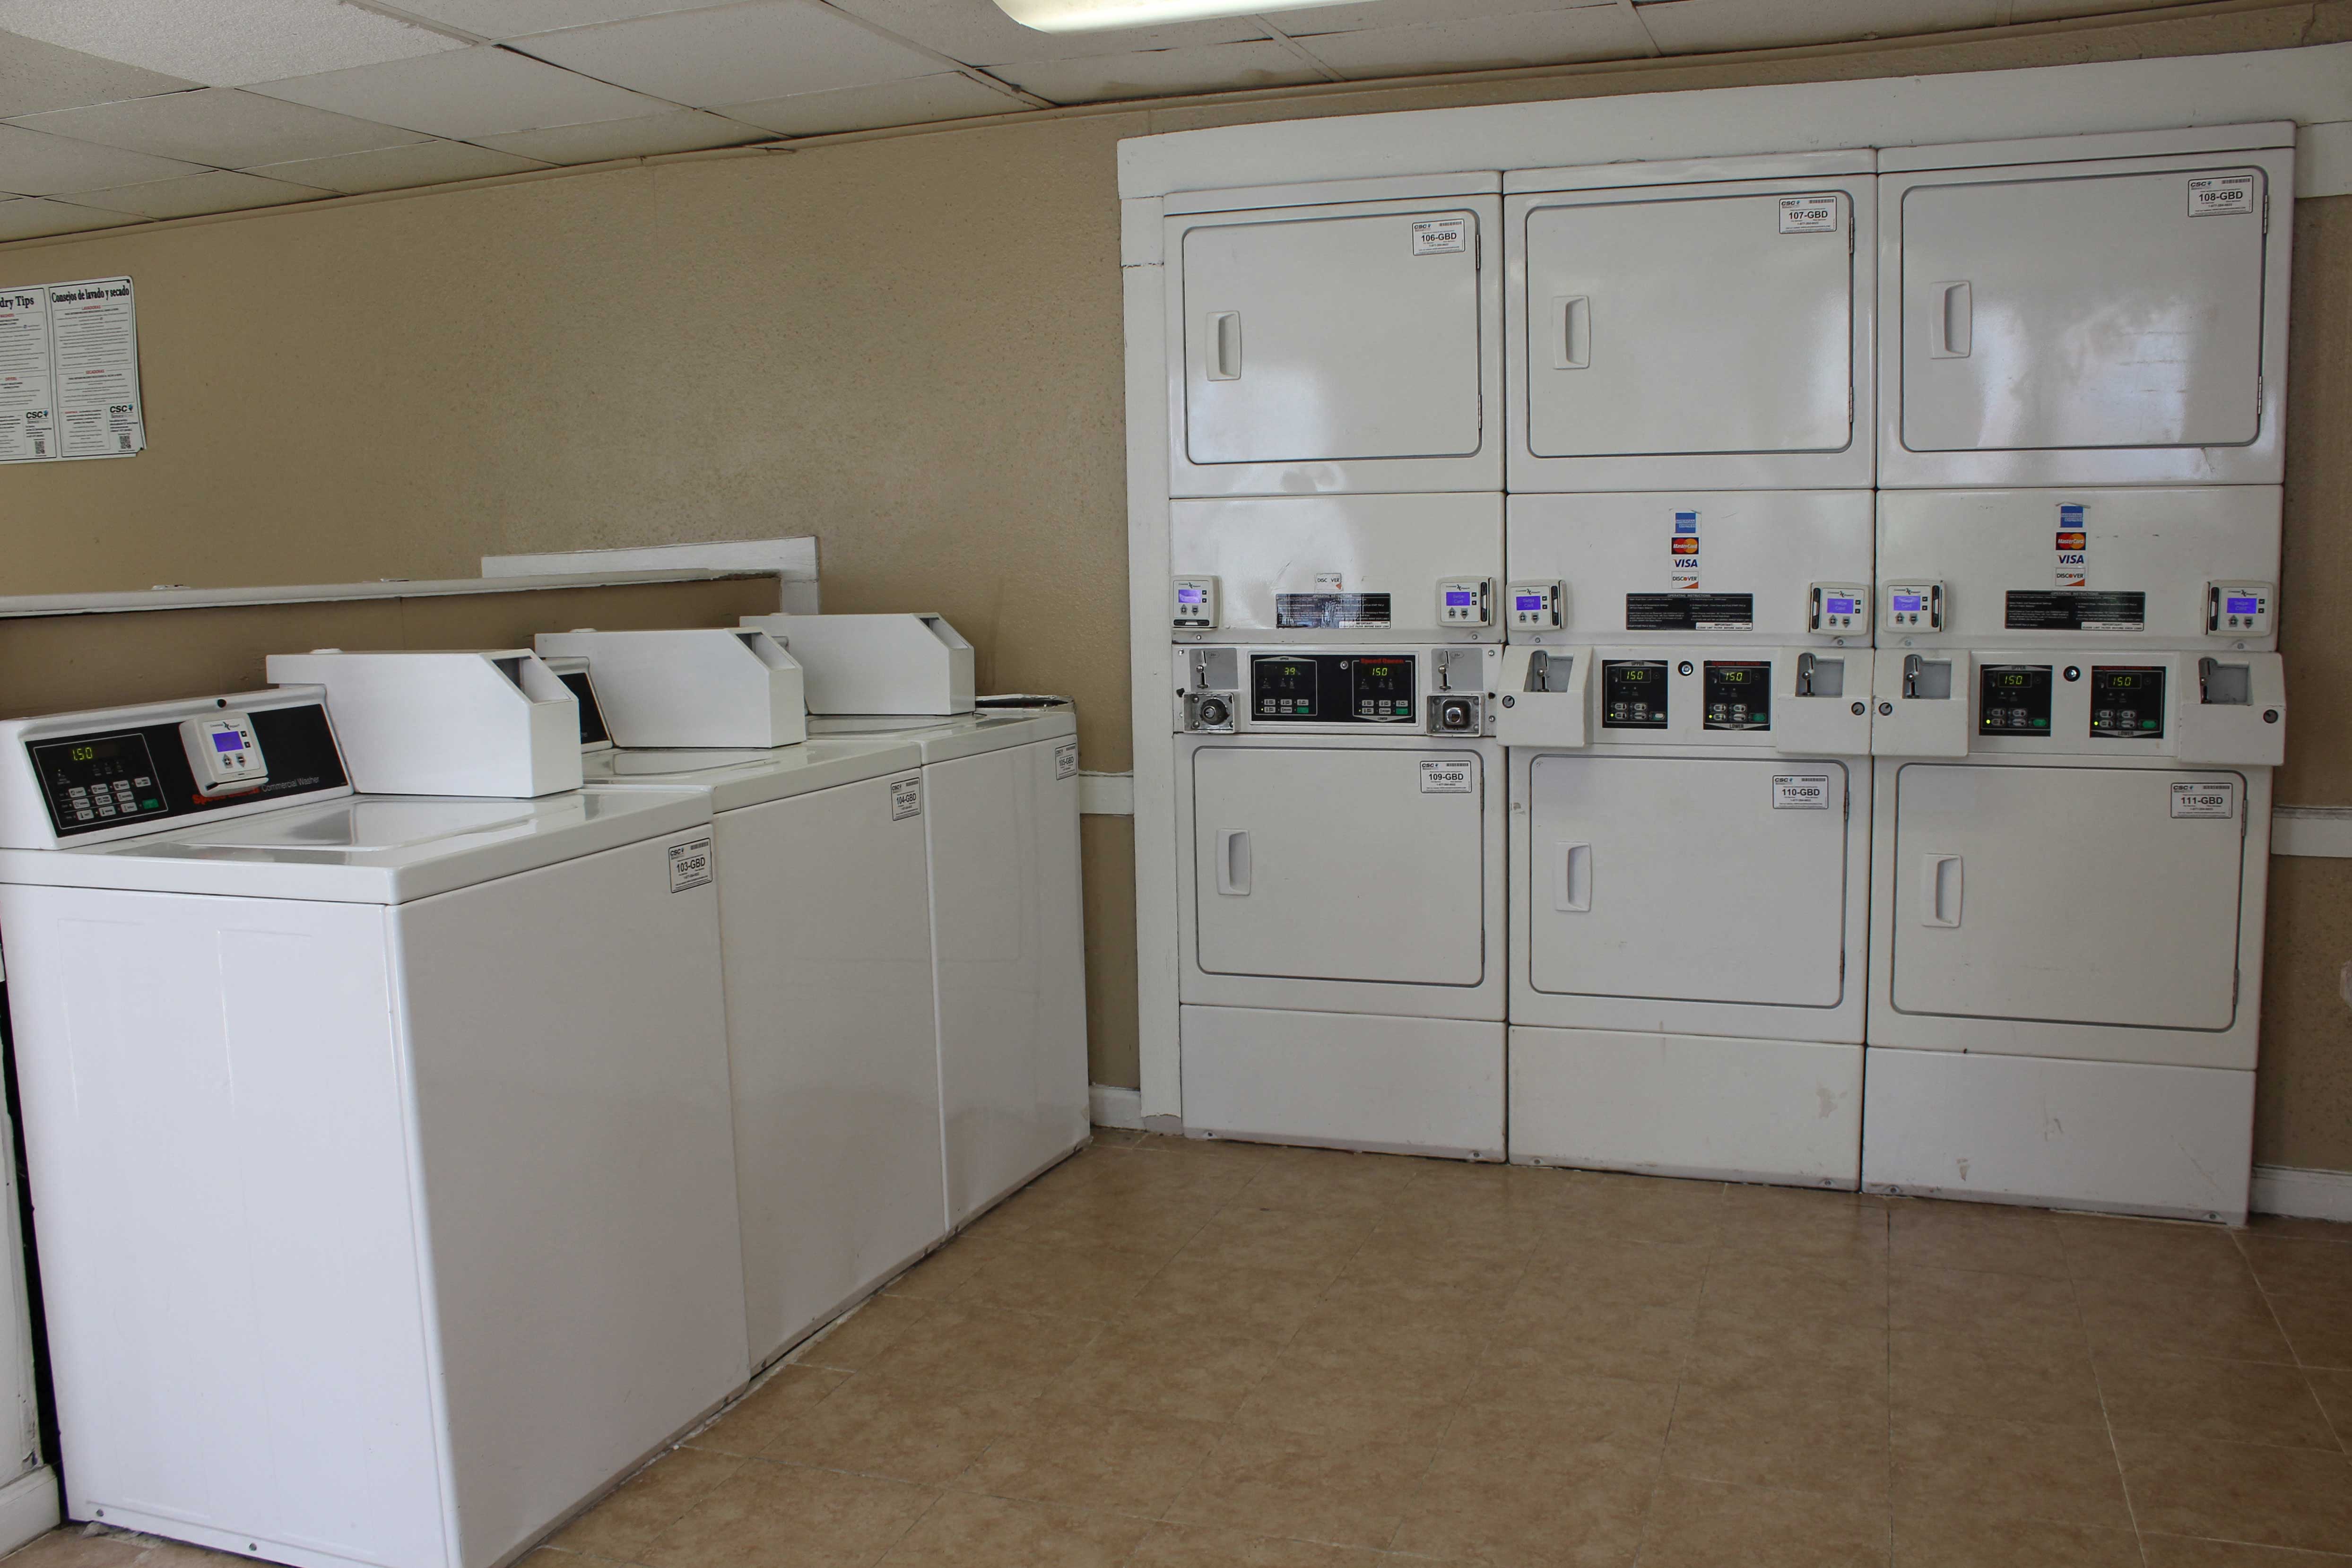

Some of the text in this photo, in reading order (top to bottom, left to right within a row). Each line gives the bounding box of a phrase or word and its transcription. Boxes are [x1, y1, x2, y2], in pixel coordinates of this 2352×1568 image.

[2199, 191, 2243, 201] 108-GBD
[1789, 210, 1828, 219] 107-GBD
[1422, 233, 1457, 242] 106-GBD
[52, 285, 130, 304] Consejos de lavado y secado
[15, 295, 34, 309] Tips
[110, 405, 127, 413] CSC
[1673, 559, 1698, 567] VISA
[2057, 555, 2084, 563] VISA
[1284, 667, 1295, 675] 39
[1372, 667, 1388, 676] 150
[1627, 671, 1643, 680] 150
[2005, 676, 2022, 684] 150
[2113, 676, 2131, 686] 150
[72, 747, 93, 761] 1.50
[261, 776, 320, 792] Commercial Washer
[896, 793, 916, 805] 104-GBD
[677, 857, 705, 873] 103-GBD
